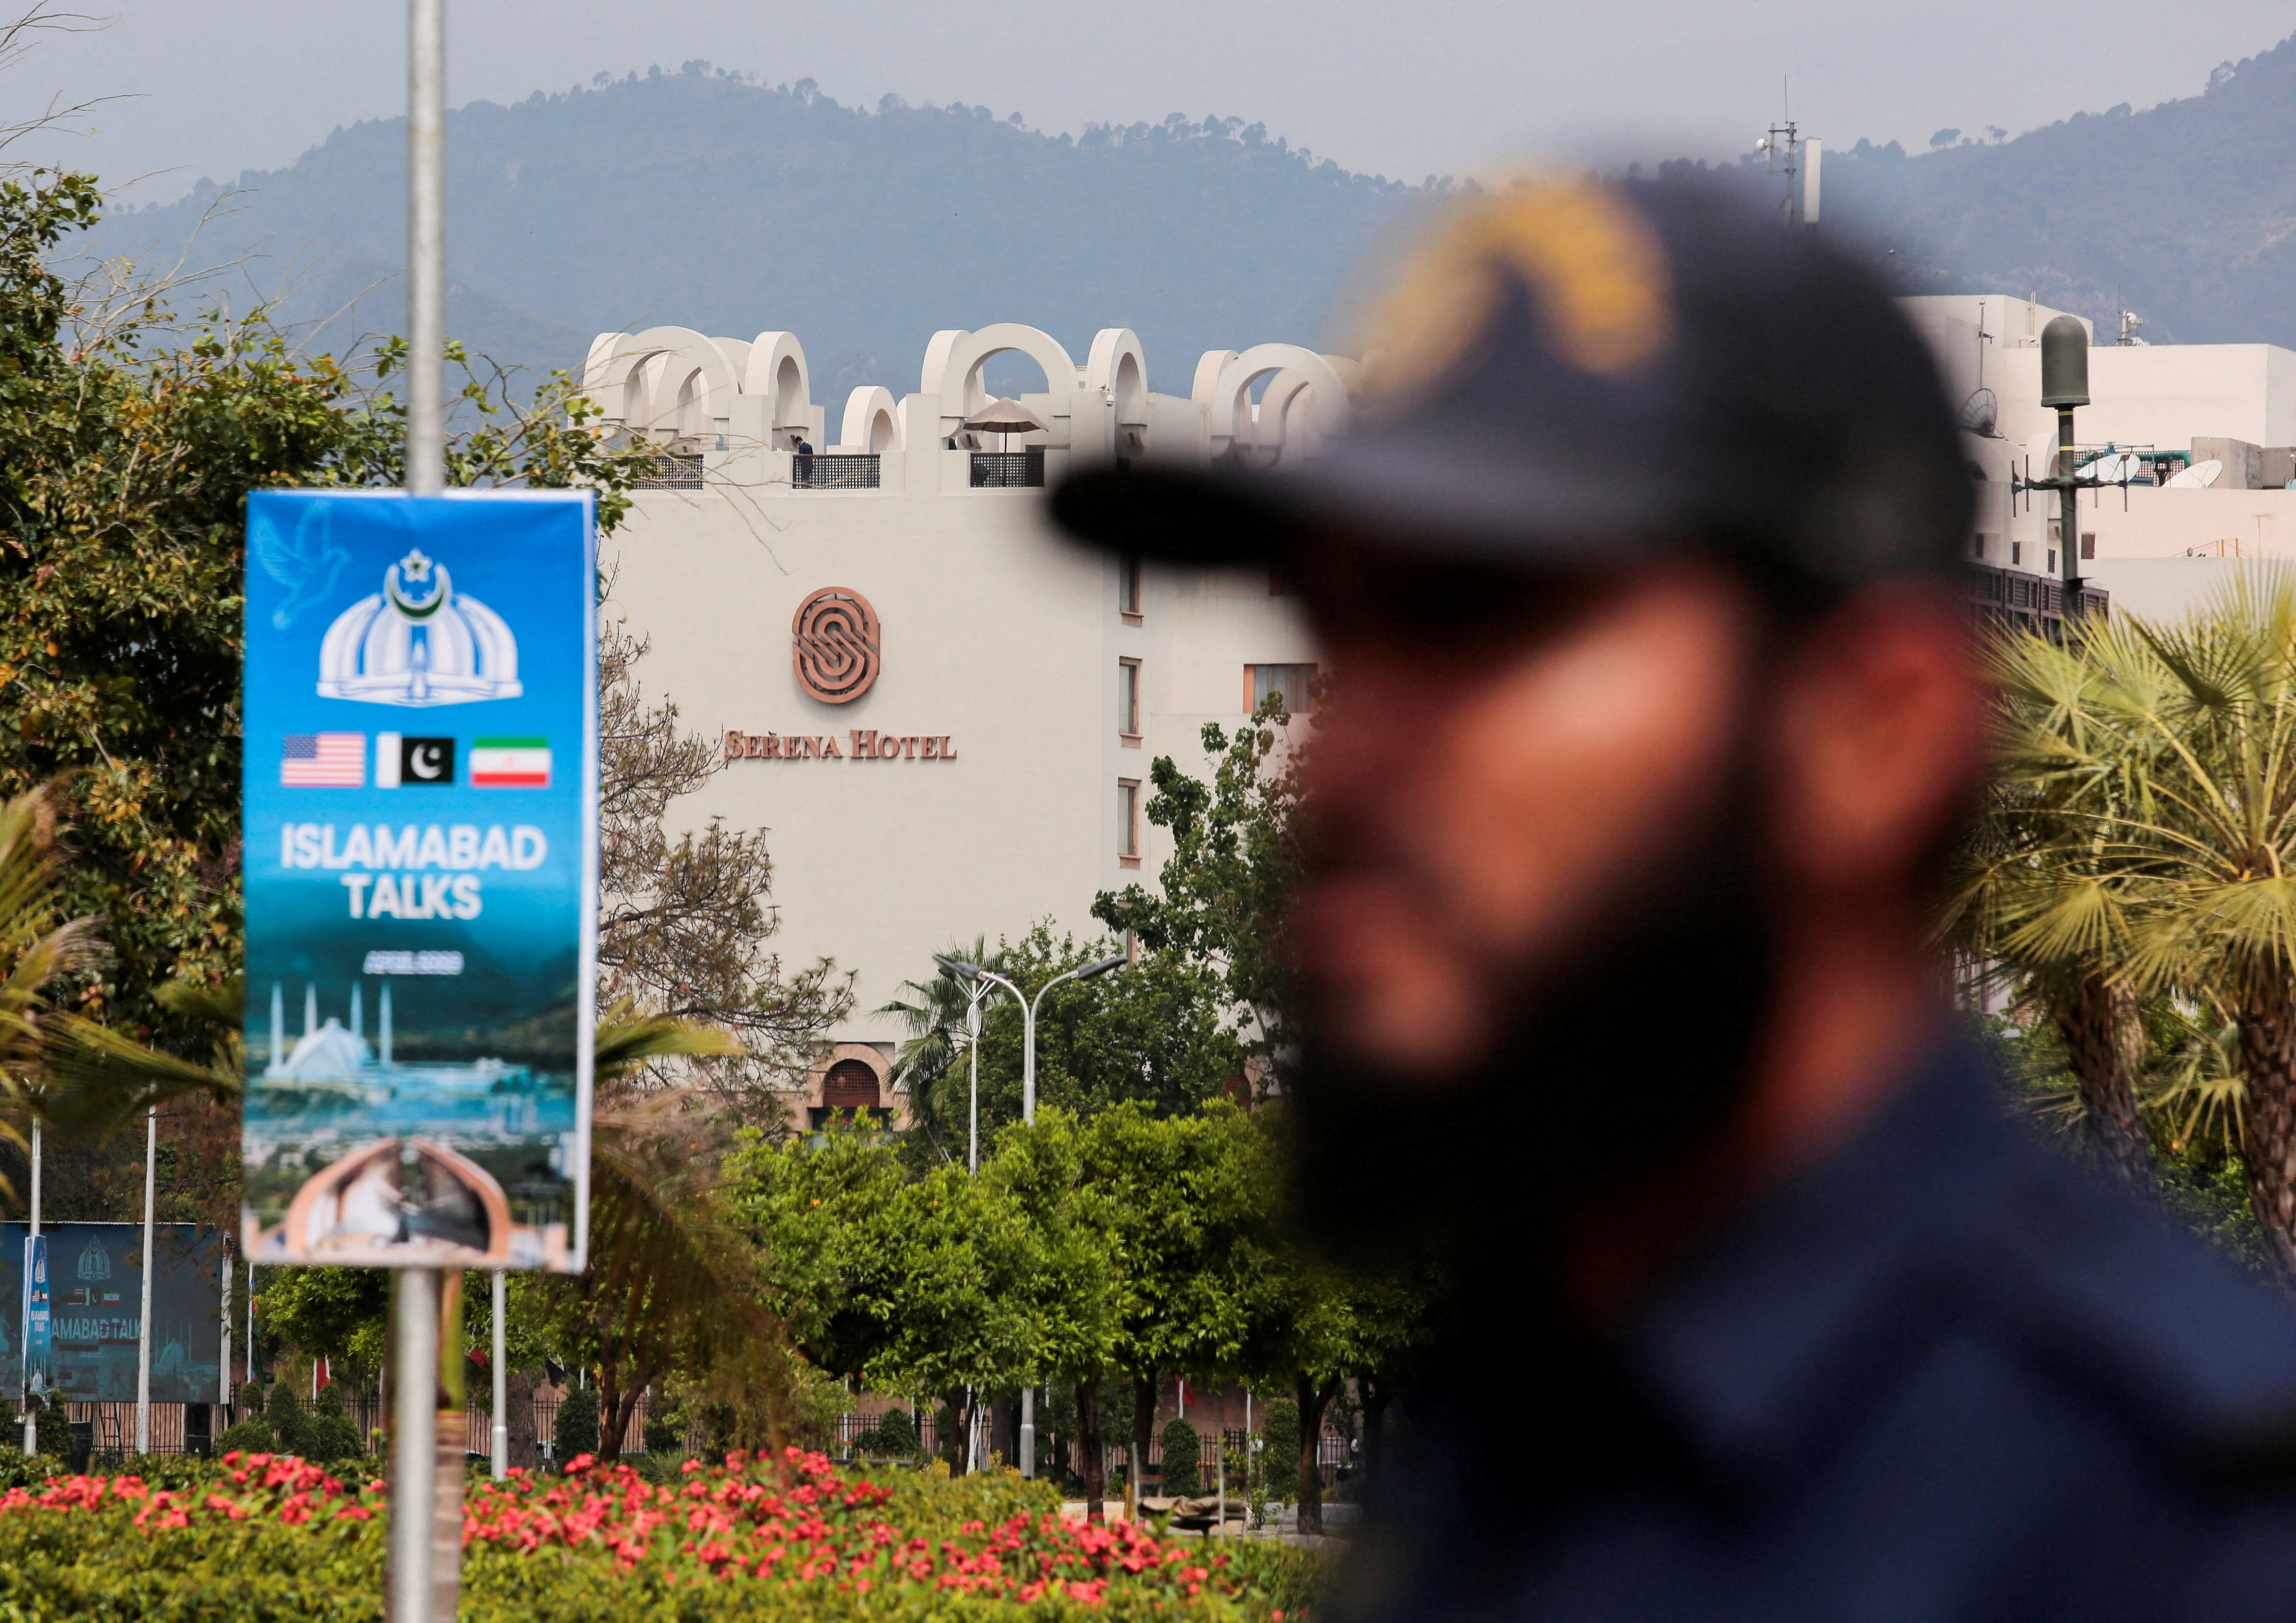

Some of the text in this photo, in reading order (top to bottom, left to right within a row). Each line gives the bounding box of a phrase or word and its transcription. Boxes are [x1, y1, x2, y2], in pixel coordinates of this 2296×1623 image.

[725, 729, 957, 759] SERENA HOTEL
[281, 823, 547, 871] ISLAMABAD
[340, 873, 483, 920] TALKS
[111, 1318, 141, 1339] TALK
